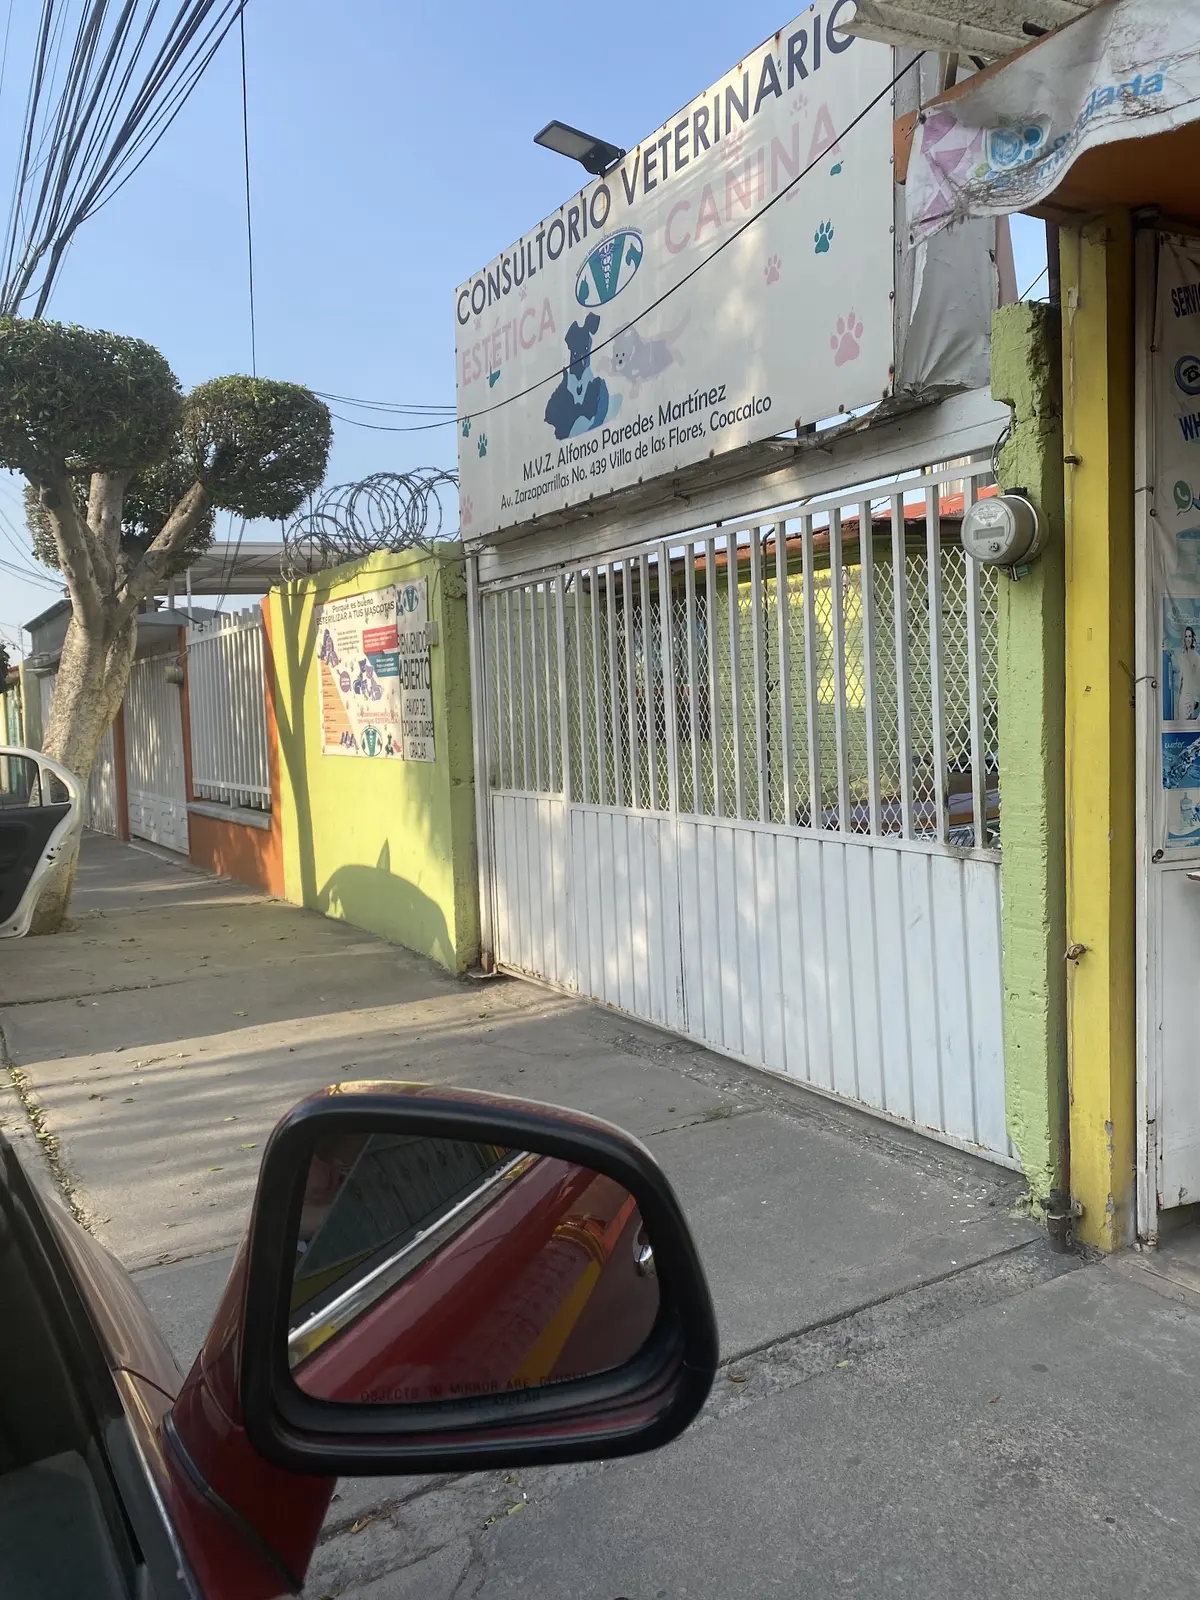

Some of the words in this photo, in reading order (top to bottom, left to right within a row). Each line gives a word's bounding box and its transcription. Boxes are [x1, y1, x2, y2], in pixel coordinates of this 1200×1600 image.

[457, 184, 611, 325] CONSULTORIO
[621, 0, 860, 206] VETERINARIO
[461, 296, 556, 388] ESTÉTICA
[664, 101, 842, 254] CANINA
[1172, 282, 1200, 318] SERVI
[501, 494, 513, 510] Av.
[515, 473, 570, 505] Zarzaparrillas
[571, 466, 588, 484] No.
[590, 458, 607, 477] 439
[609, 447, 632, 469] Villa
[634, 441, 648, 460] de
[651, 436, 666, 454] las
[669, 422, 706, 448] Flores,
[709, 396, 772, 432] Coacalco
[523, 453, 555, 481] M.V.Z.
[557, 439, 598, 468] Alfonso
[602, 413, 654, 450] Paredes
[658, 384, 727, 427] Martínez
[353, 608, 364, 618] TUS
[399, 657, 431, 690] ABIERTO
[429, 1385, 443, 1399] IN
[450, 1379, 499, 1395] MIRROR
